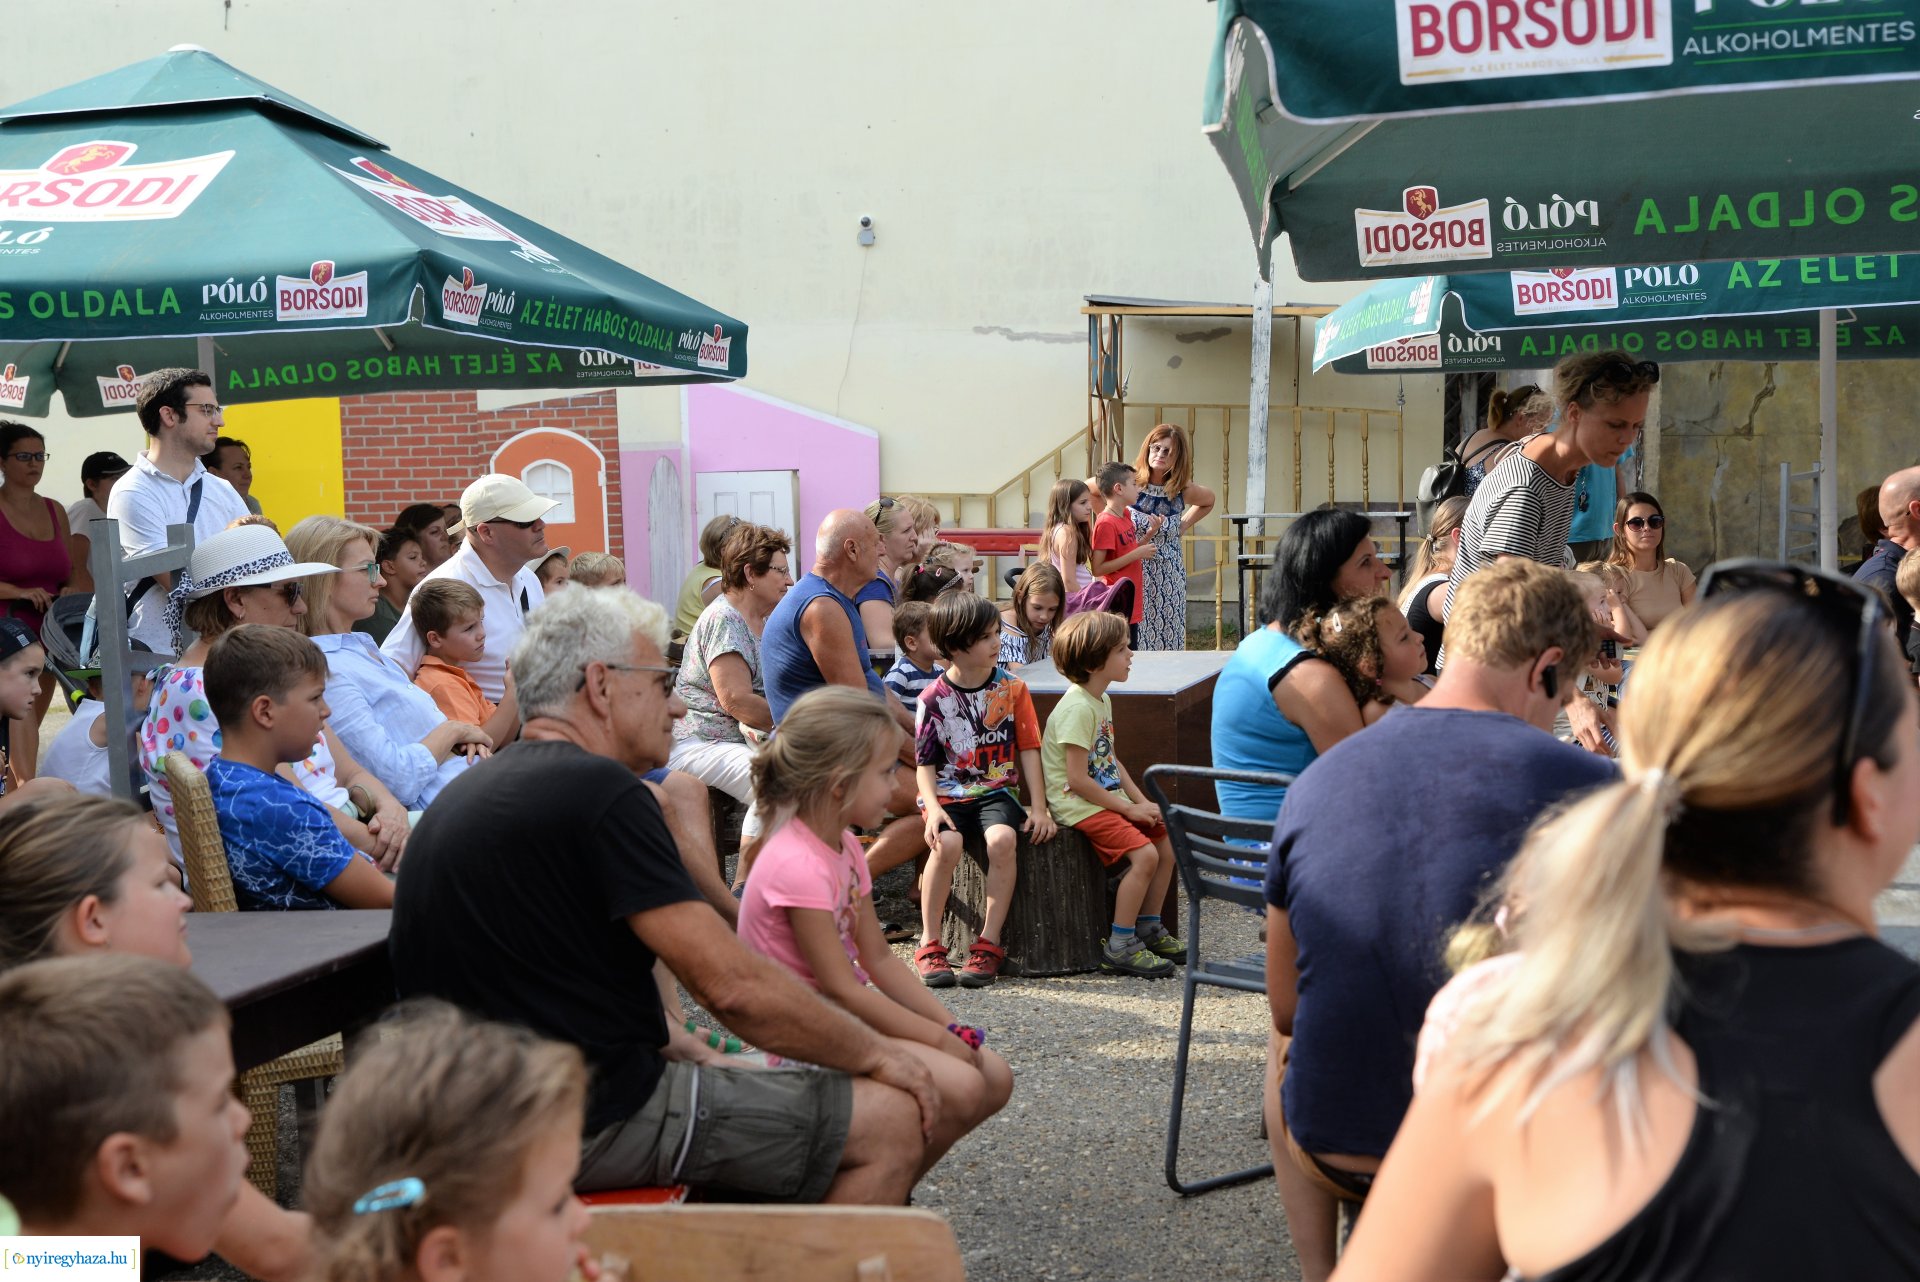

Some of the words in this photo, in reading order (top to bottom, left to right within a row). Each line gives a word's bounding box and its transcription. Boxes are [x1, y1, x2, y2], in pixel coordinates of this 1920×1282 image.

[1408, 0, 1657, 58] BORSODI
[1682, 21, 1916, 56] ALKOHOLMENTES
[0, 174, 199, 208] RSODI
[1727, 259, 1782, 289] AZ
[28, 287, 182, 319] OLDALA
[202, 275, 268, 305] PÓLÓ
[279, 286, 363, 311] BORSODI
[443, 288, 483, 317] BORSODI
[484, 287, 516, 315] PÓLÓ
[1517, 277, 1612, 305] BORSODI
[1622, 292, 1707, 304] ALKOHOLMENTES
[199, 309, 274, 321] ALKOHOLMENTES
[520, 299, 544, 326] AZ
[545, 295, 583, 331] ÉLET
[583, 307, 630, 342] HABOS
[628, 319, 674, 352] OLDALA
[677, 328, 702, 351] PÓLÓ
[699, 343, 728, 363] BORSODI
